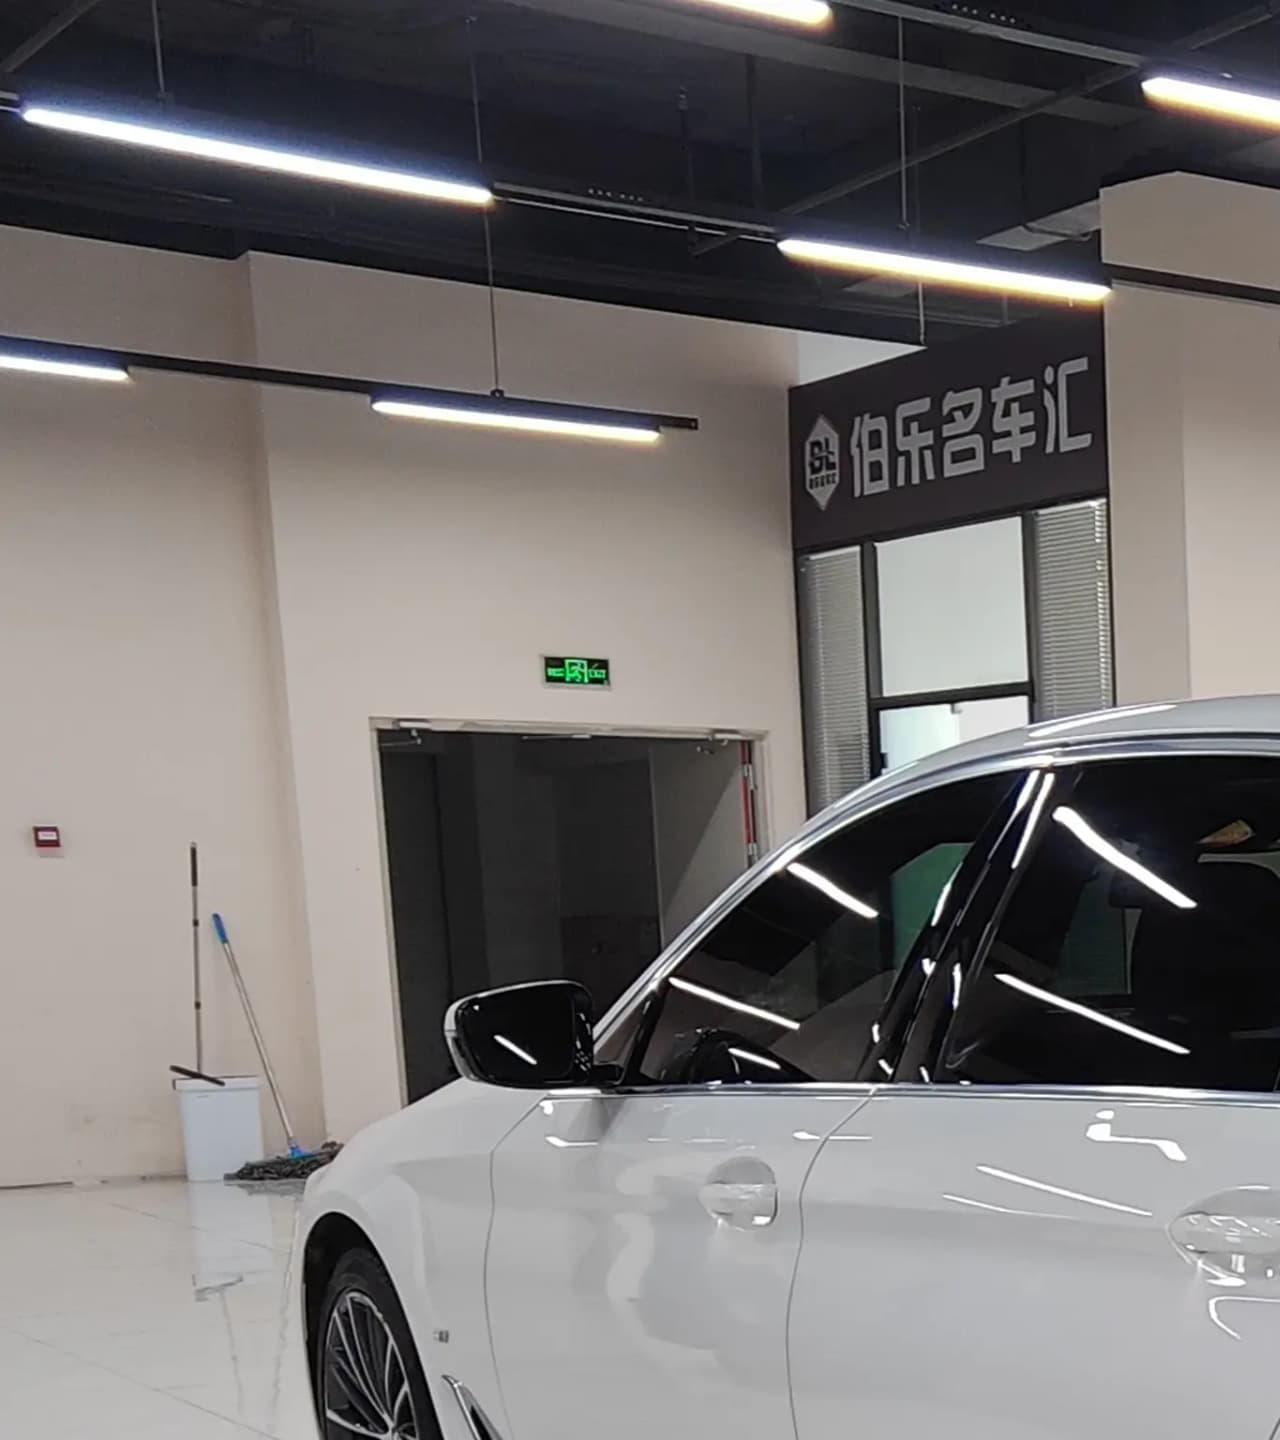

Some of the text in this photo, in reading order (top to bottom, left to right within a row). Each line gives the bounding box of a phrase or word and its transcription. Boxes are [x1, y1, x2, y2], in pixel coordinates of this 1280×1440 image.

[850, 356, 1093, 498] 伯乐名车汇
